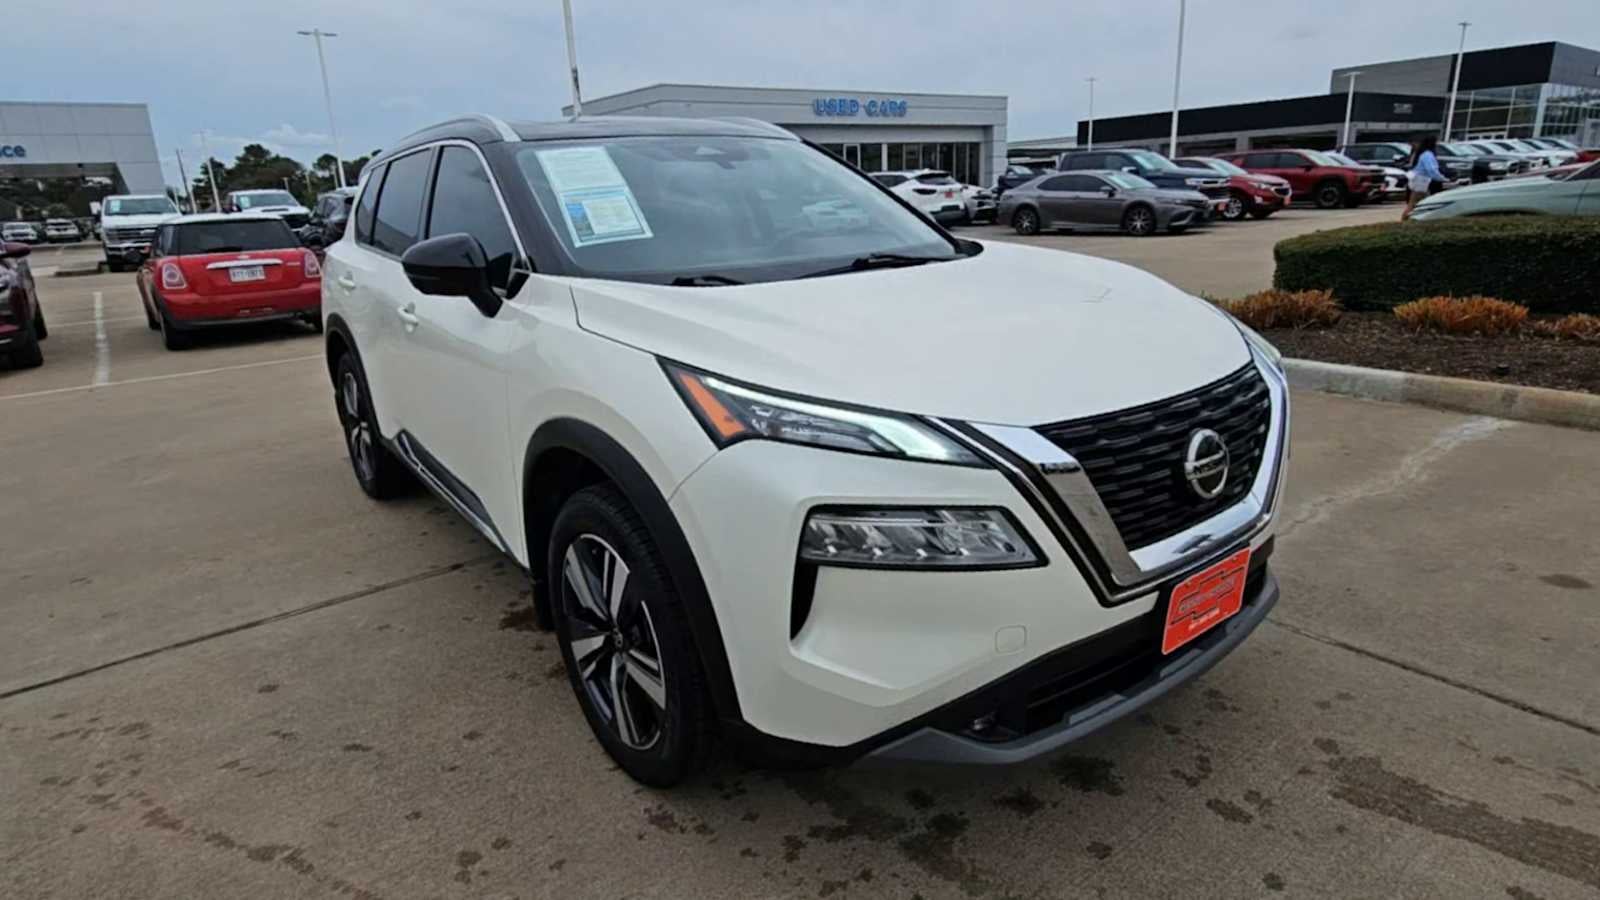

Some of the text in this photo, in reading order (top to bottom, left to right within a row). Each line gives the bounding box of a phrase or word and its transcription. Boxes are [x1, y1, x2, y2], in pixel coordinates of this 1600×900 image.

[814, 97, 907, 117] USED CARS
[0, 145, 26, 158] ce
